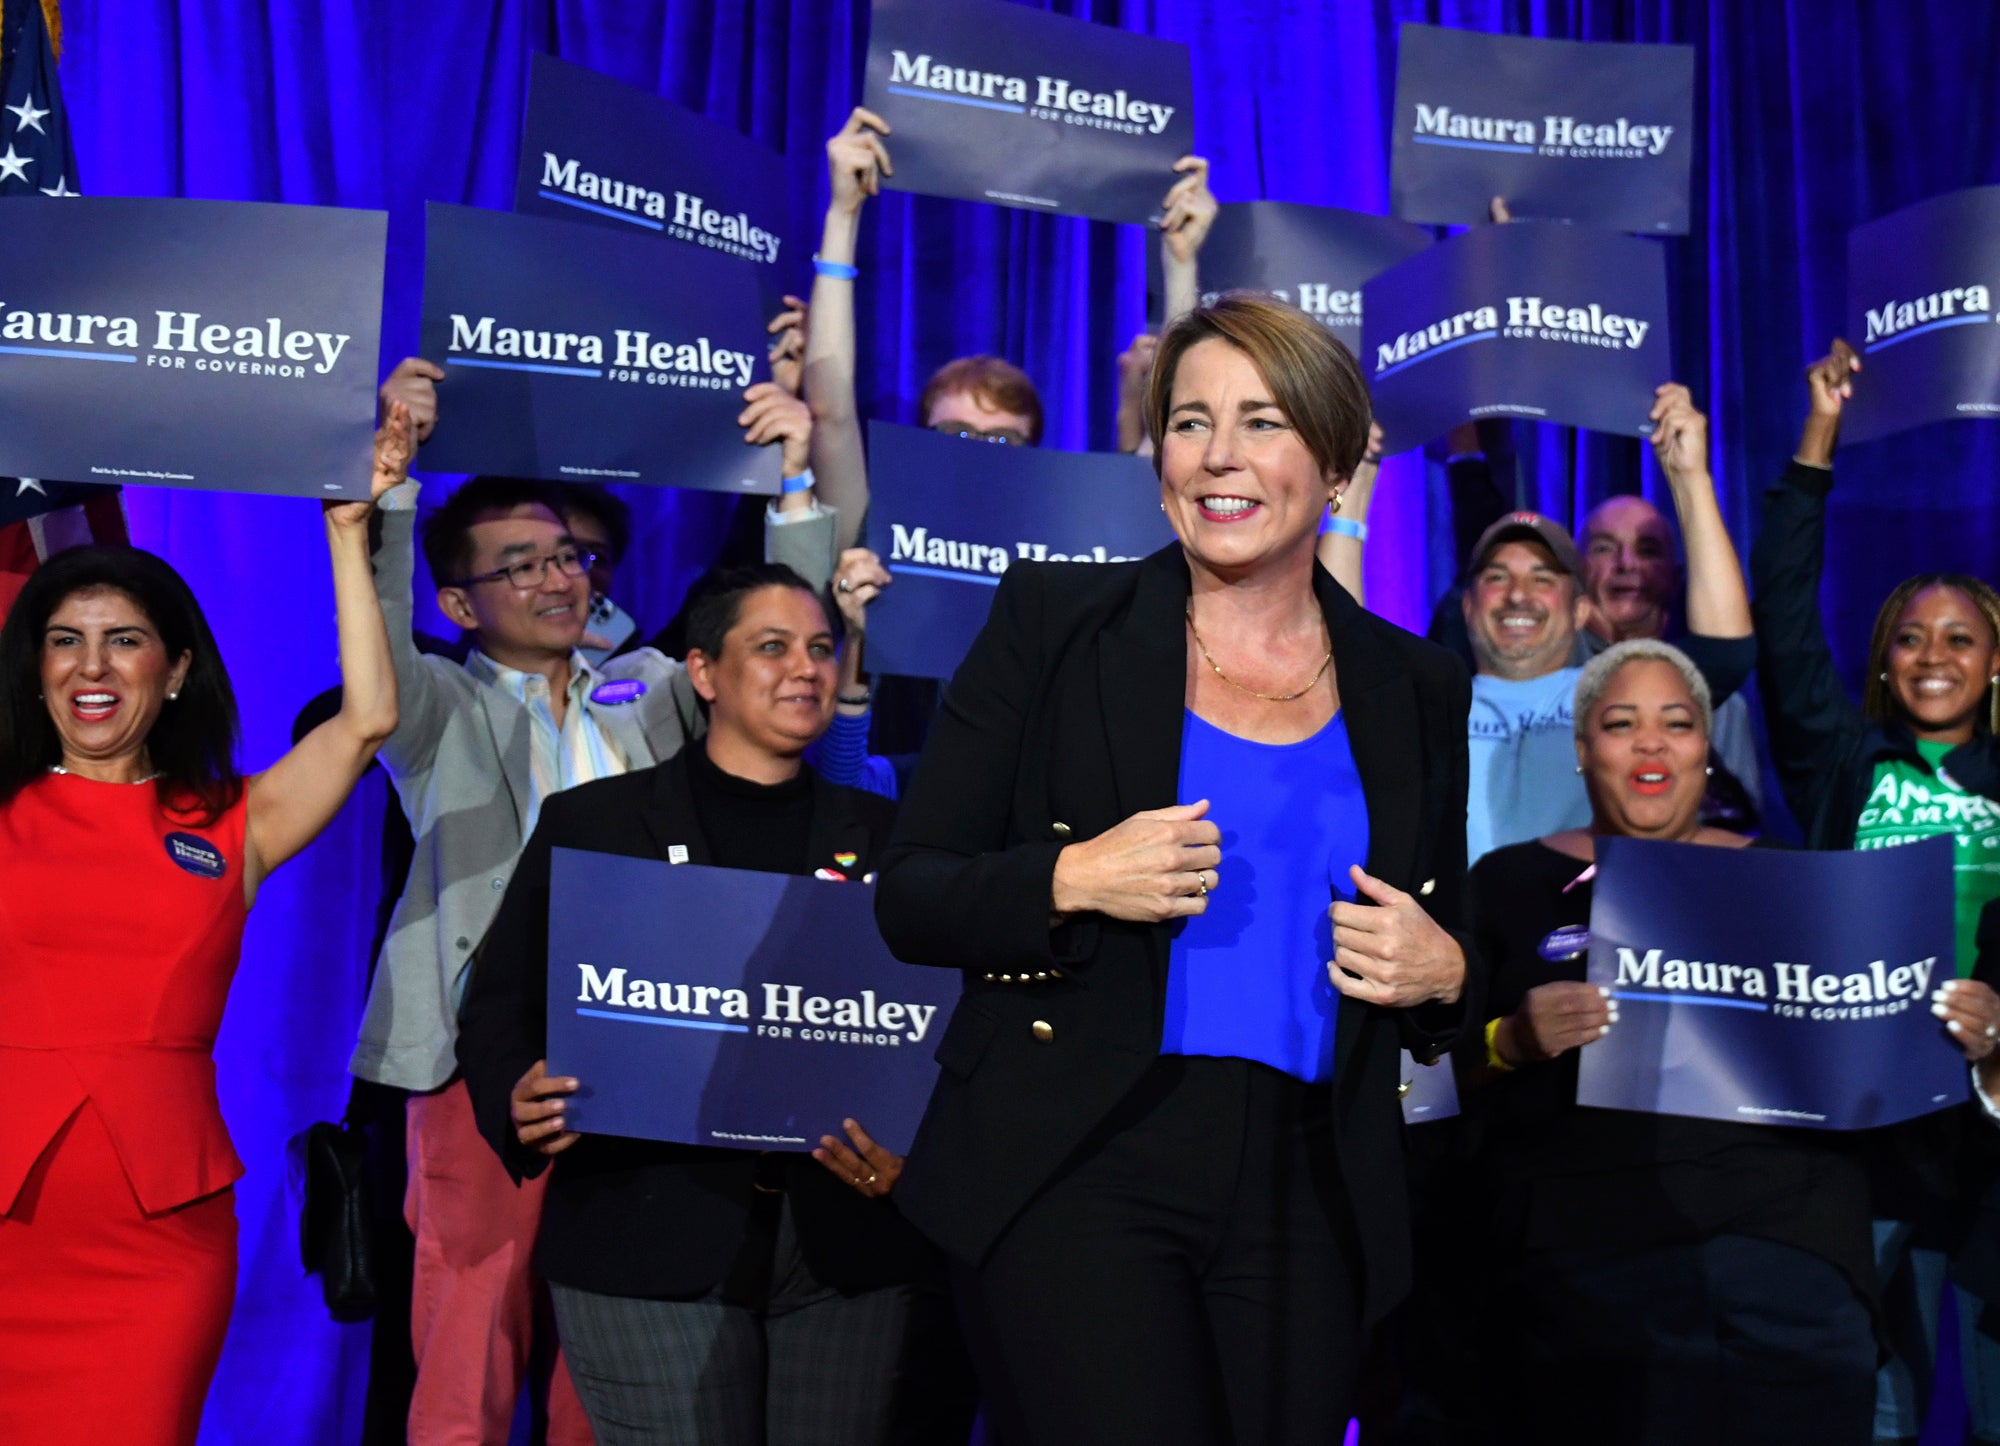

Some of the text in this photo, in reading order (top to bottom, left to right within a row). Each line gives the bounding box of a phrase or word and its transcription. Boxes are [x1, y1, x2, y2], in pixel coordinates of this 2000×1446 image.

[889, 50, 1175, 134] Maura Healey
[1031, 108, 1145, 135] FOR GOVERNOR
[1414, 103, 1673, 155] Maura Healey
[540, 151, 781, 263] Maura Healey
[1297, 283, 1363, 314] Hea
[1866, 285, 1990, 342] Maura
[0, 302, 351, 374] aura Healey
[448, 314, 755, 387] Maura Healey
[1376, 296, 1649, 372] Maura Healey
[1503, 327, 1622, 350] FOR GOVERNOR
[146, 354, 306, 378] FOR GOVERNOR
[609, 369, 732, 391] FOR GOVERNOR
[890, 524, 1009, 574] Maura
[1615, 947, 1938, 1004] Maura Healey
[577, 963, 937, 1042] Maura Healey
[1773, 1001, 1909, 1020] FOR GOVERNOR
[757, 1024, 901, 1046] FOR GOVERNOR
